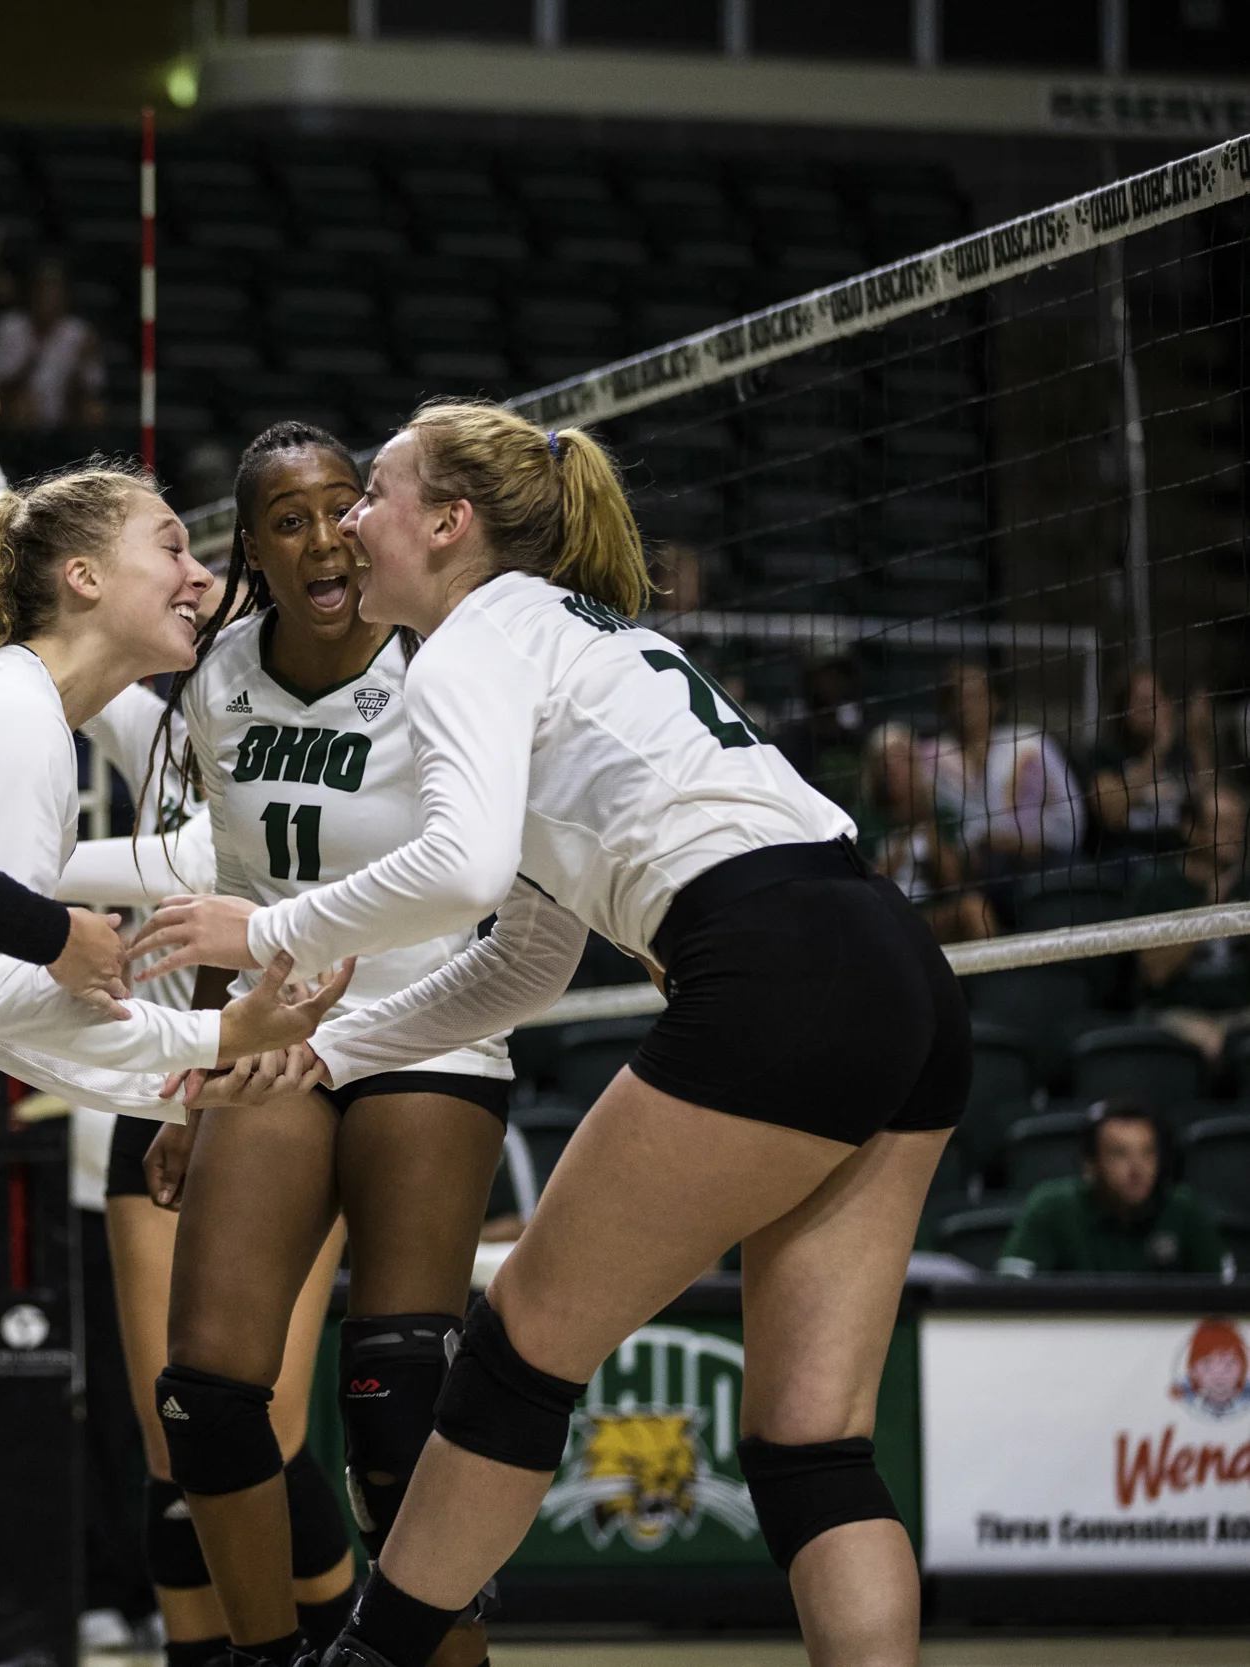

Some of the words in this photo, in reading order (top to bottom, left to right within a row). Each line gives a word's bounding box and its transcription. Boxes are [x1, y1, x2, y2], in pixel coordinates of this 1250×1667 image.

[1090, 187, 1128, 233] OHIO
[1130, 158, 1201, 220] BOBCATS
[956, 236, 991, 281] OHIO
[993, 213, 1056, 270] BOBCATS
[559, 593, 648, 634] OHI
[226, 703, 253, 714] adidas
[356, 698, 387, 709] MAC
[232, 725, 372, 793] OHIO
[260, 801, 322, 881] 11
[977, 1513, 1048, 1544] Three
[1059, 1513, 1207, 1544] Convenient
